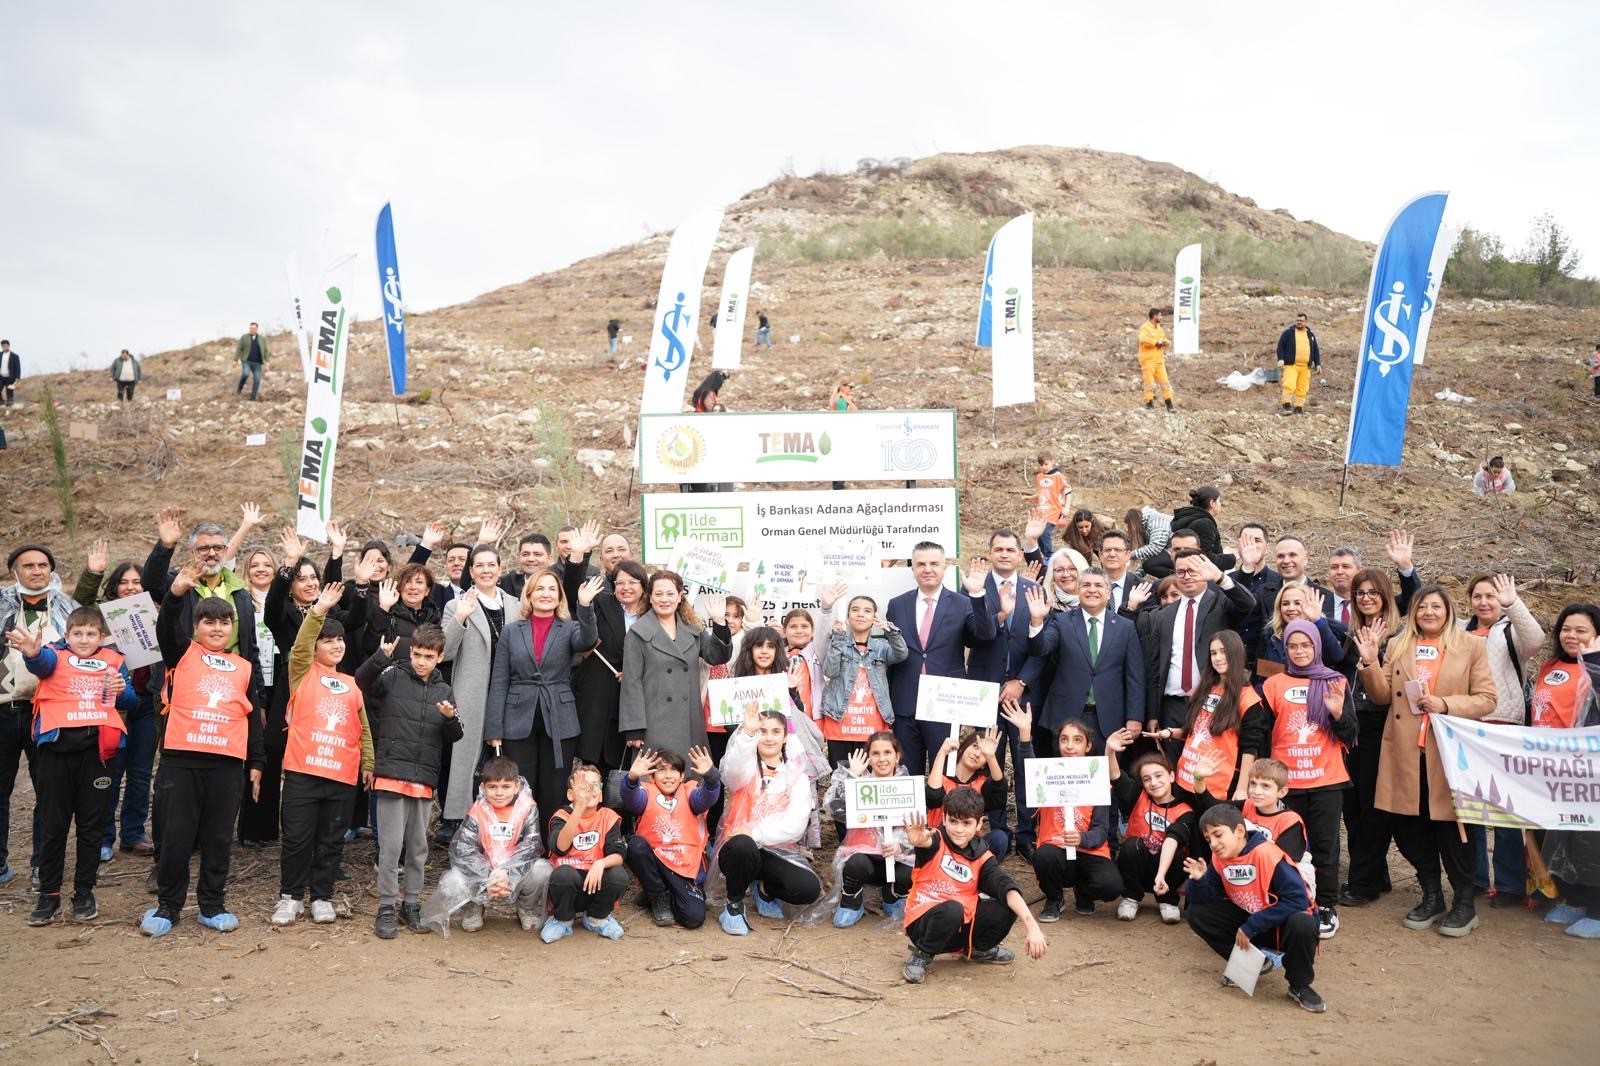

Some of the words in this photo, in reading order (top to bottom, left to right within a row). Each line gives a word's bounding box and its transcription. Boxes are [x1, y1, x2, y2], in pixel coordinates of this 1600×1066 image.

[1179, 287, 1192, 323] TEMA
[1005, 298, 1017, 334] TEMA
[314, 311, 337, 383] TEMA
[758, 432, 815, 453] TEMA
[880, 438, 938, 471] 100
[298, 440, 323, 510] TEMA
[757, 503, 766, 517] İş
[769, 504, 813, 516] Bankası
[816, 504, 853, 515] Adana
[856, 502, 944, 516] Ağaçlandırması
[761, 527, 796, 537] Orman
[798, 525, 827, 536] Genel
[829, 525, 884, 537] Müdürlüğü
[886, 524, 940, 534] Tarafından
[734, 688, 765, 700] ADANA
[1292, 689, 1307, 697] TEM
[845, 704, 874, 714] ÜRKİYE
[67, 711, 108, 720] OLMASIN
[841, 726, 876, 735] OLMASIN
[186, 733, 229, 747] OLMASIN
[1287, 745, 1322, 757] TÜRKİYE
[305, 755, 342, 771] OLMASIN
[1296, 757, 1314, 769] ÇÖL
[1500, 753, 1594, 779] TOPRAĞI
[879, 784, 898, 794] ilde
[879, 795, 912, 805] orman
[1558, 813, 1586, 823] TEMA
[1228, 868, 1248, 877] TEMA
